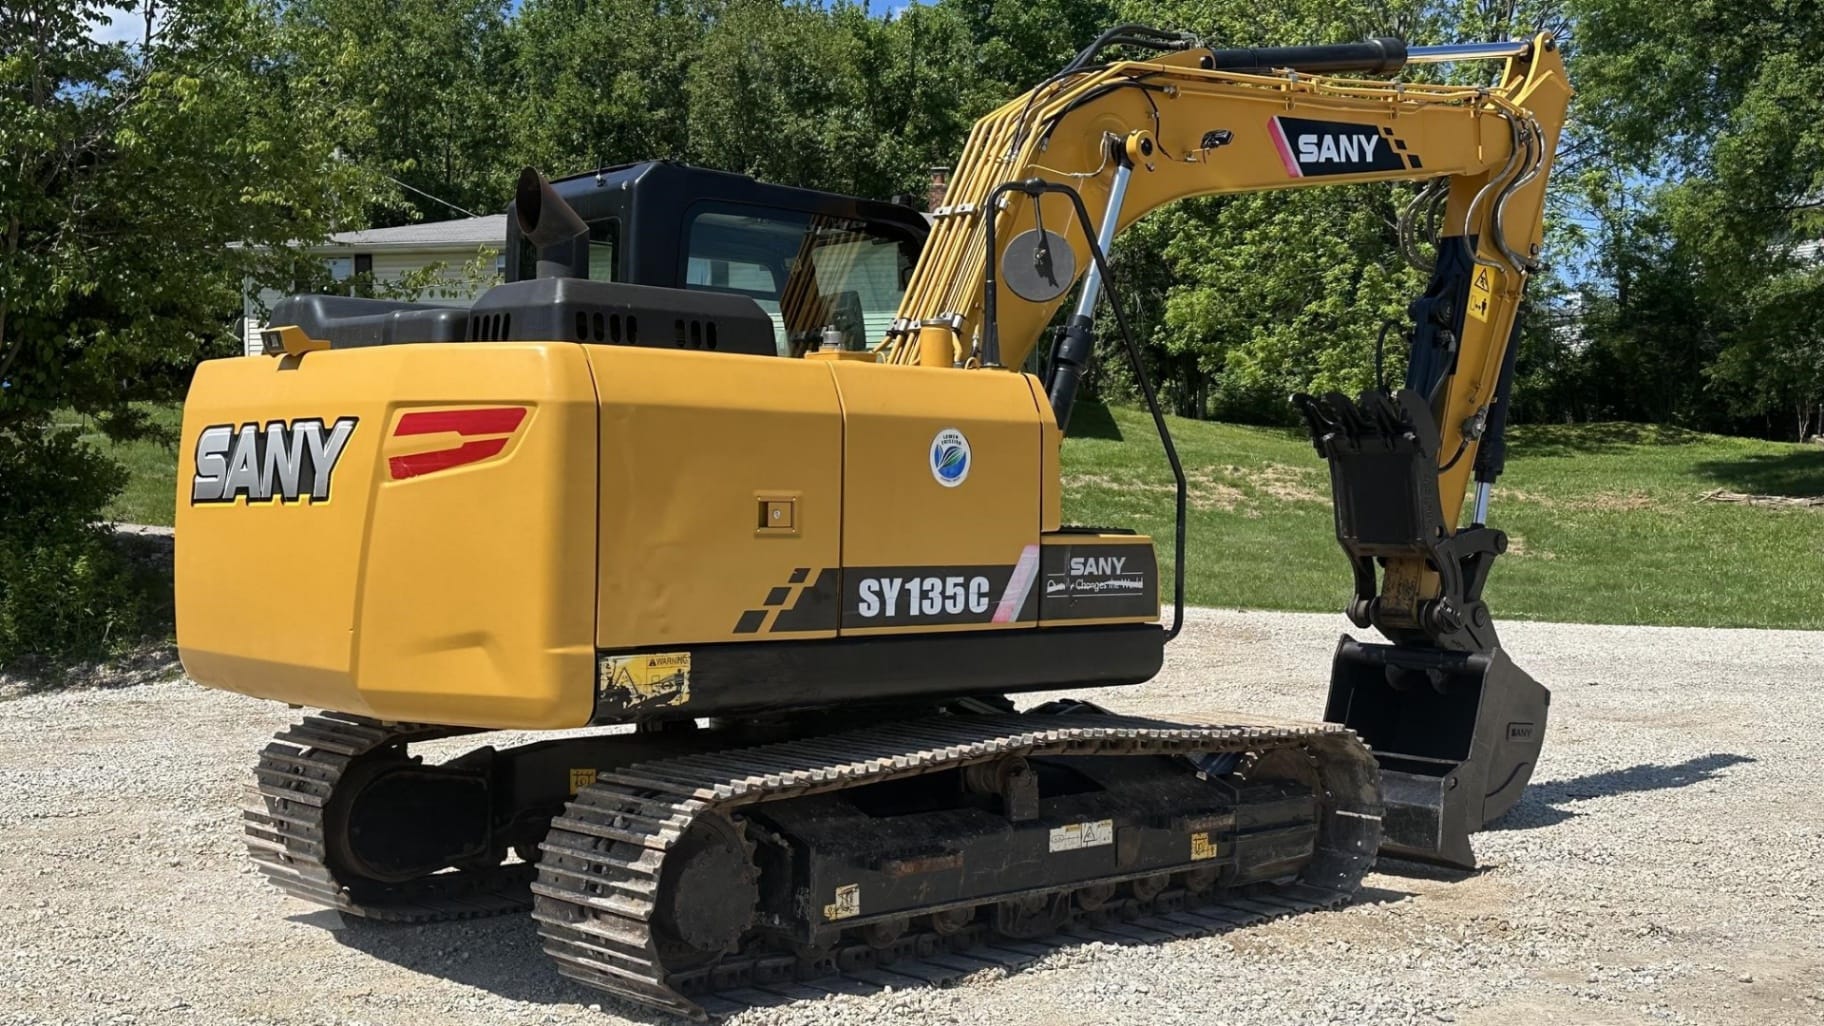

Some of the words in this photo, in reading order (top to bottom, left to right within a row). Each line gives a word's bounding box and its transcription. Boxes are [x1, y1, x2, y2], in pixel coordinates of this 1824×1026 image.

[1298, 134, 1379, 162] SANY
[192, 416, 359, 506] SANY
[1070, 557, 1126, 576] SANY
[858, 576, 990, 617] SY135C
[656, 654, 689, 665] WARNING
